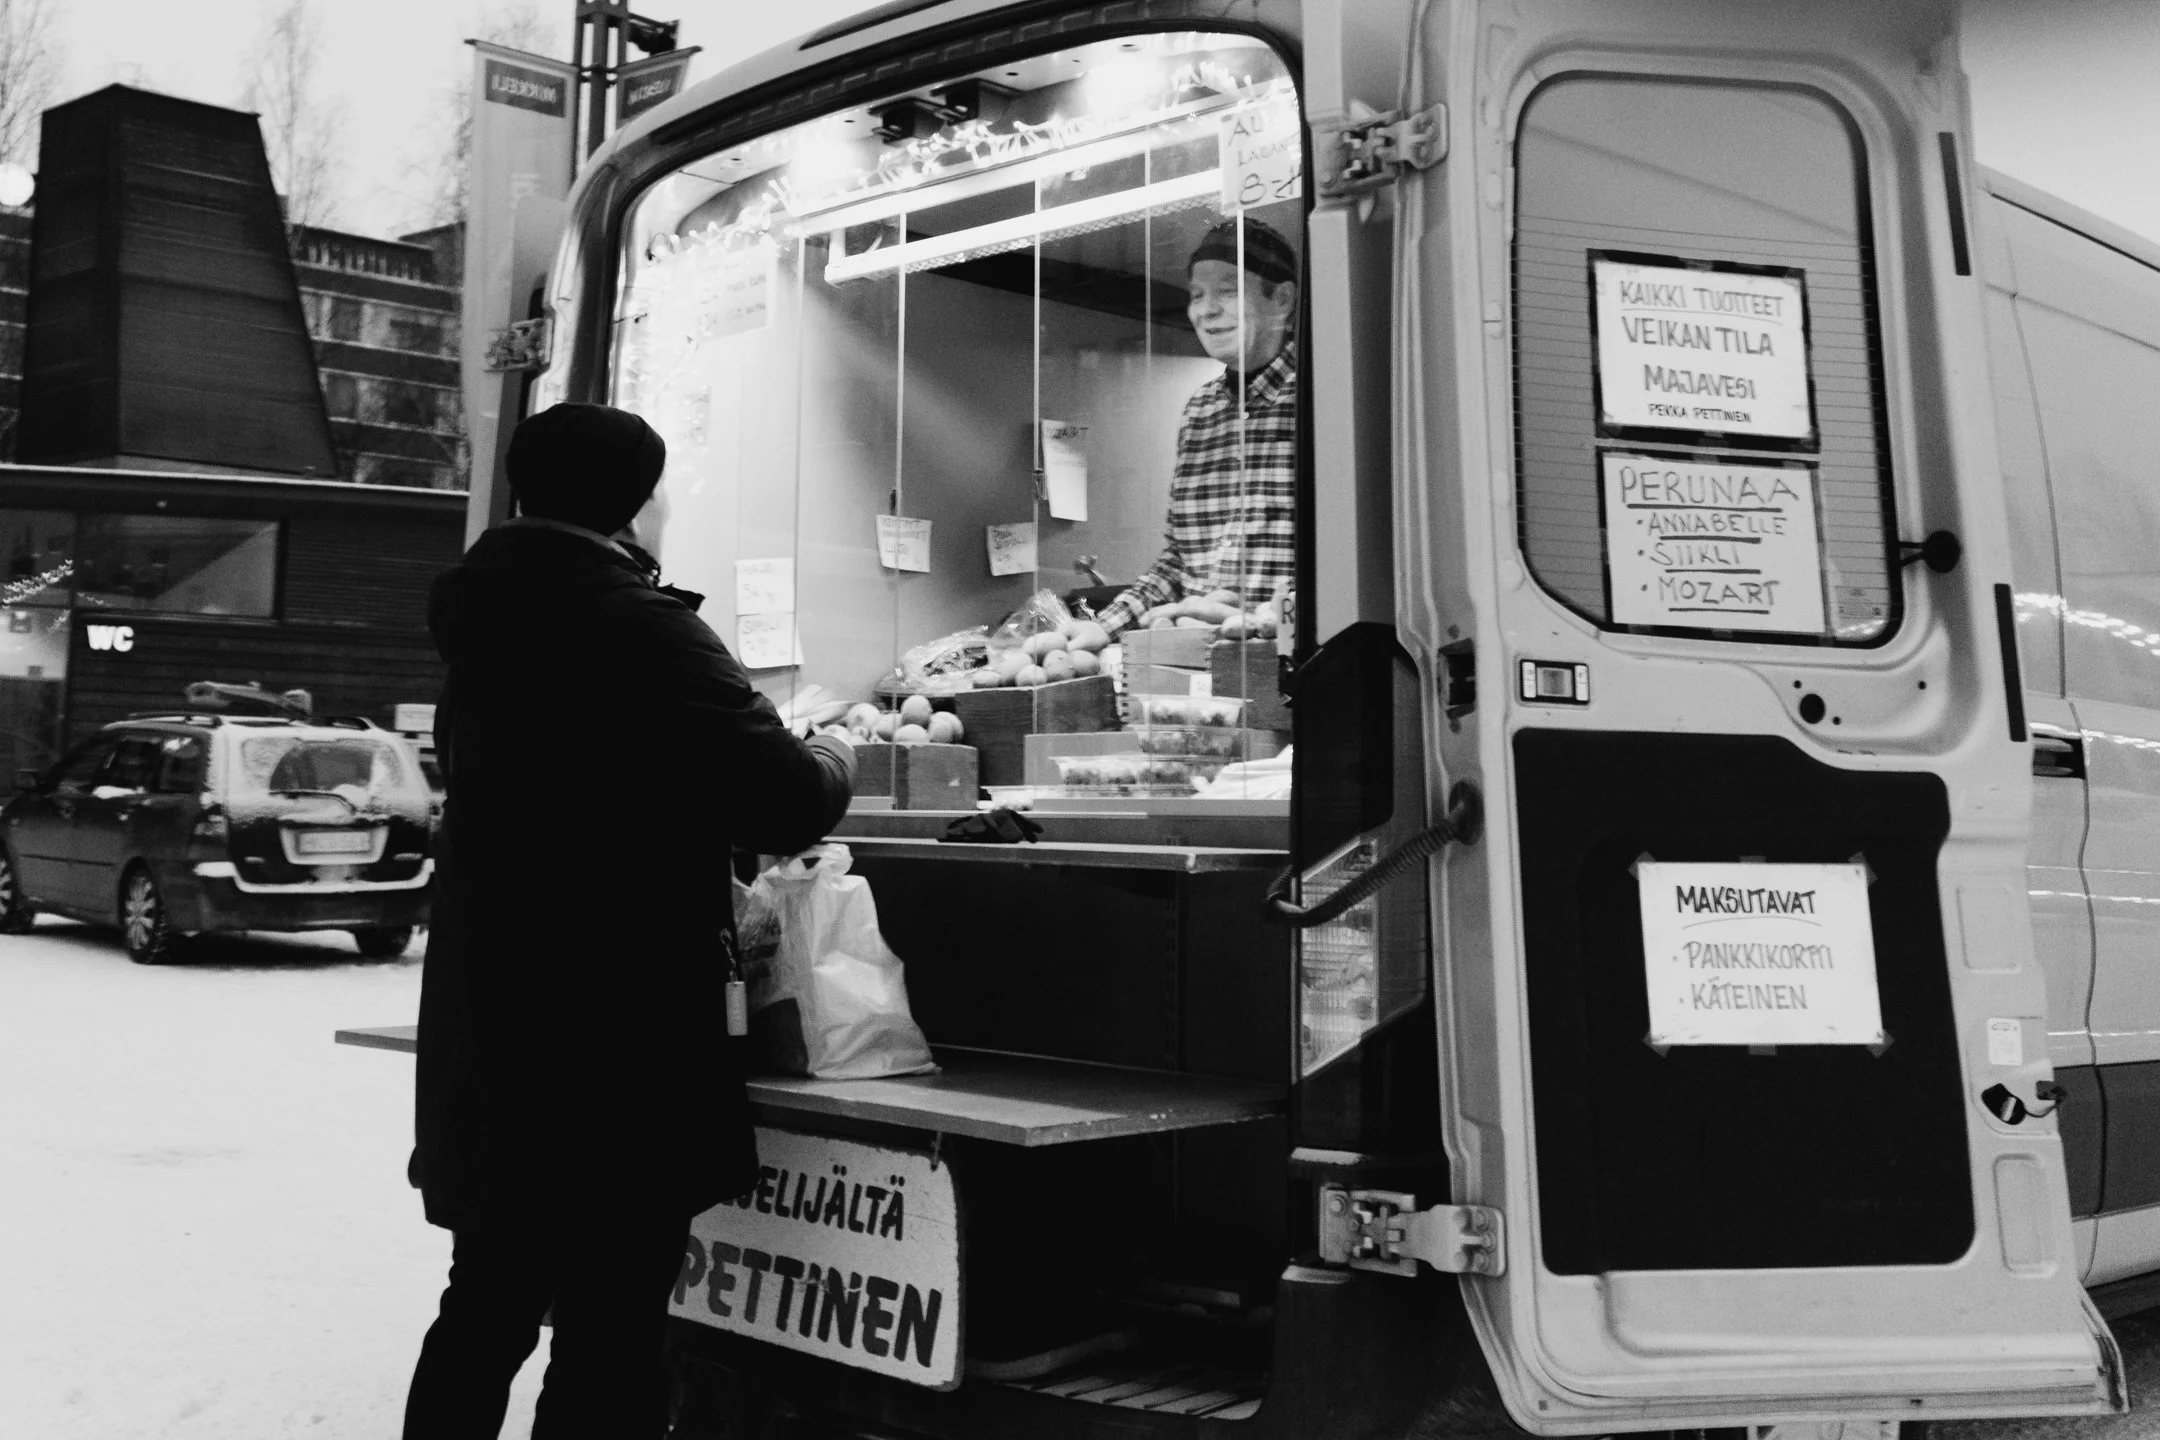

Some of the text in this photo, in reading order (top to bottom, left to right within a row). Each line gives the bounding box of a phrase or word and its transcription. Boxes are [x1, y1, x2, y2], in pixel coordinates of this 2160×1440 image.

[1619, 280, 1785, 317] KAIKKI TUOTTEET
[1621, 315, 1775, 357] VEIKAN TILA
[1643, 363, 1757, 400] MAJAVESI
[1648, 403, 1752, 424] PEKKA PETTINEN
[1619, 466, 1799, 505] PERUNAA
[1648, 511, 1788, 537] ANNABELLE
[1649, 542, 1741, 566] SIIKLI
[1657, 576, 1781, 606] MOZART
[87, 625, 134, 652] WC
[1676, 885, 1816, 914] MAKSUTAVAT
[1682, 941, 1834, 969] PANKKIKORTTI
[1690, 975, 1809, 1010] KÄTEINEN
[722, 1163, 906, 1242] ELIJÄLTÄ
[673, 1234, 943, 1369] PETTINEN
